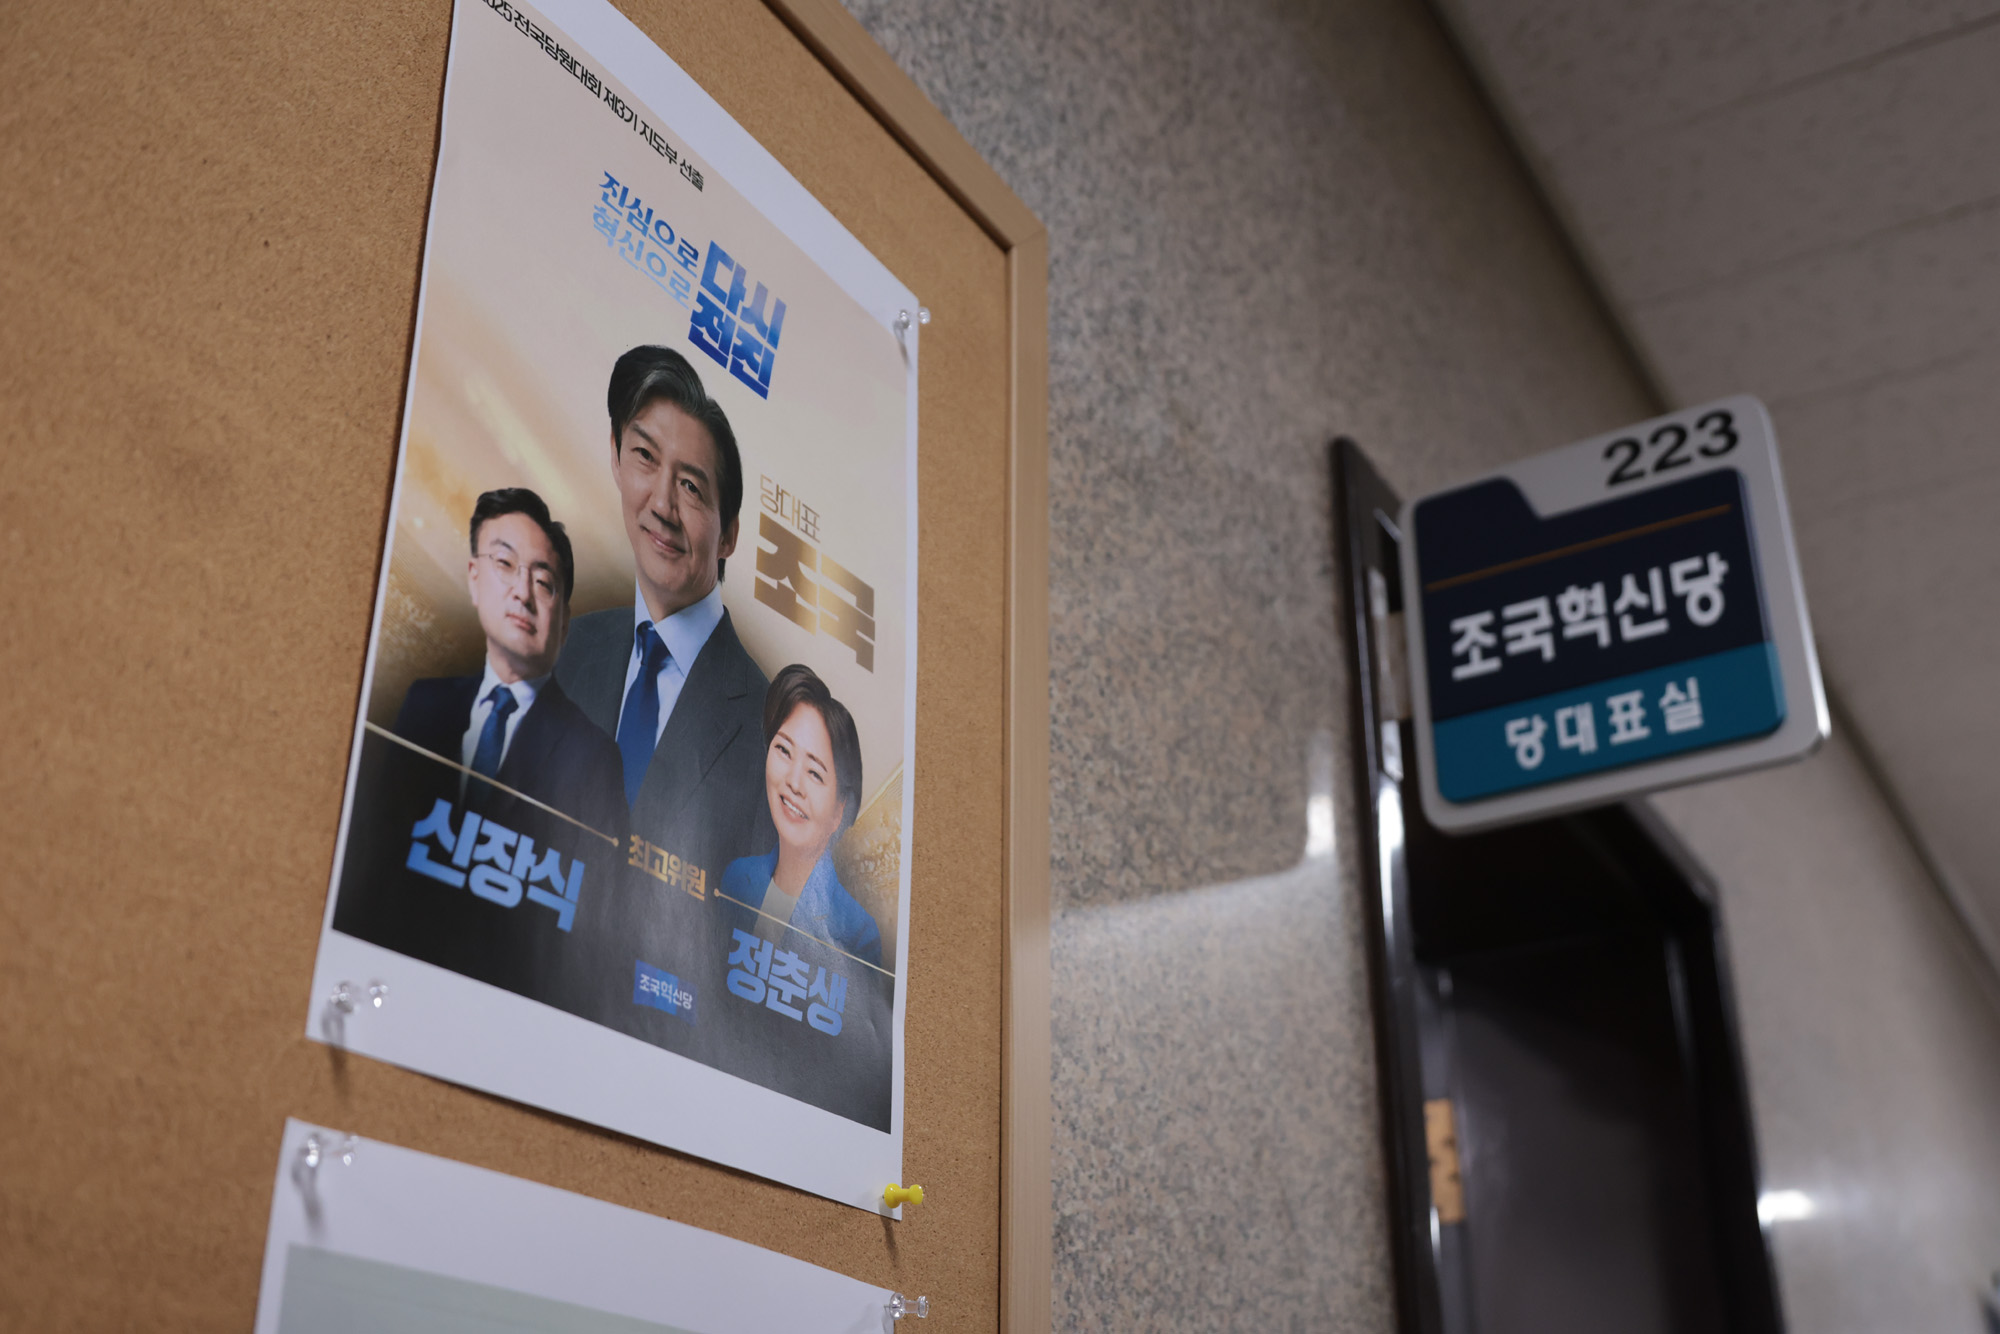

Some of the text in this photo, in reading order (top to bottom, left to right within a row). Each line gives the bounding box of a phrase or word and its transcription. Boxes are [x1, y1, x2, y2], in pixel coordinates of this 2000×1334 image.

[603, 86, 638, 131] 제3기
[639, 120, 678, 165] 지도부
[679, 159, 704, 192] 선출
[592, 204, 692, 310] 혁신으로
[599, 170, 700, 279] 진심으로
[687, 290, 775, 401] 전진
[699, 239, 787, 351] 다시
[1603, 409, 1740, 488] 223
[759, 473, 821, 544] 당대표
[753, 511, 876, 675] 조국
[1449, 551, 1730, 681] 조국혁신당
[1504, 676, 1704, 771] 당대표실
[405, 798, 586, 933] 신장식
[627, 834, 707, 902] 최고위원
[638, 972, 694, 1011] 조국혁신당
[726, 927, 849, 1037] 정춘생
